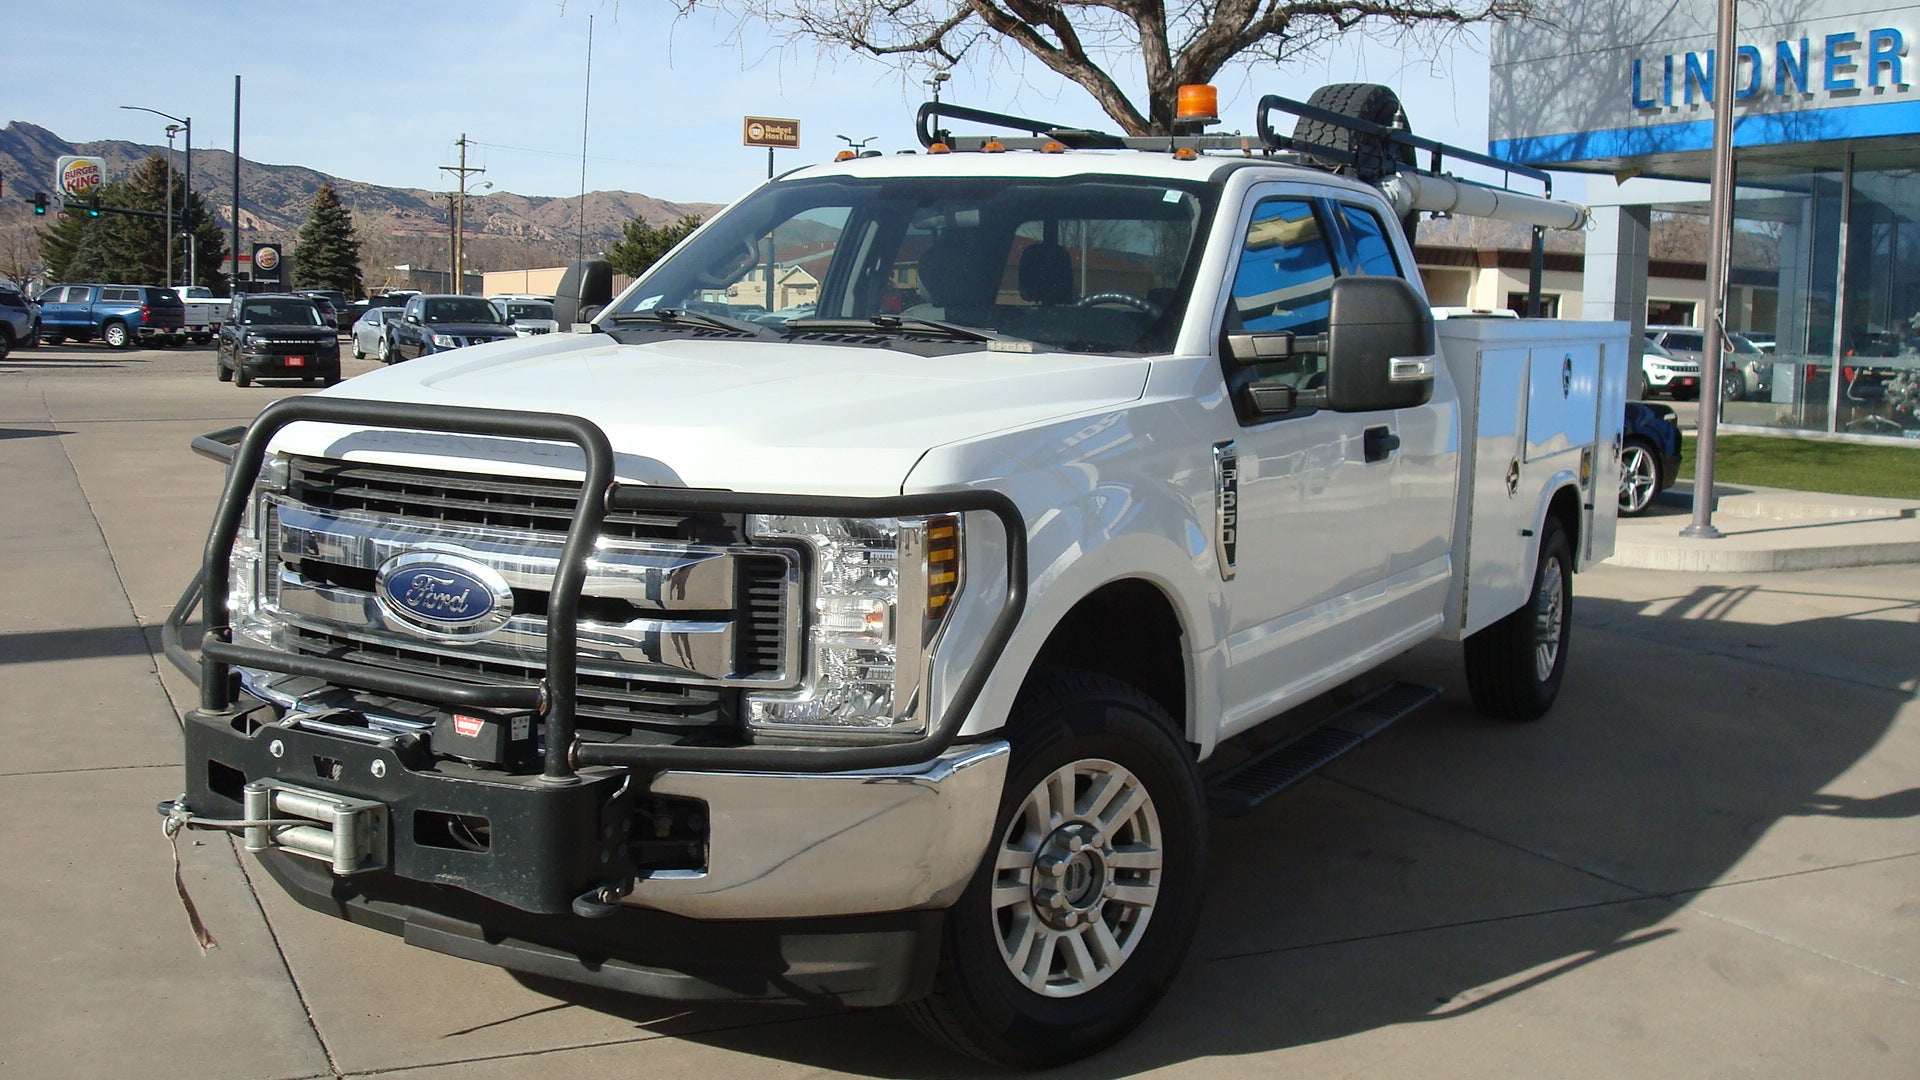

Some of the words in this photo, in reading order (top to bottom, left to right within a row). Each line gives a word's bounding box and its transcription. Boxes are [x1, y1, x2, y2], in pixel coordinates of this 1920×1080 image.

[1632, 27, 1905, 109] LINDNER
[765, 125, 792, 134] Budget
[765, 132, 783, 140] Host
[783, 133, 797, 141] Inn
[64, 165, 98, 180] BURGER
[66, 174, 100, 192] KING
[406, 573, 471, 614] Ford
